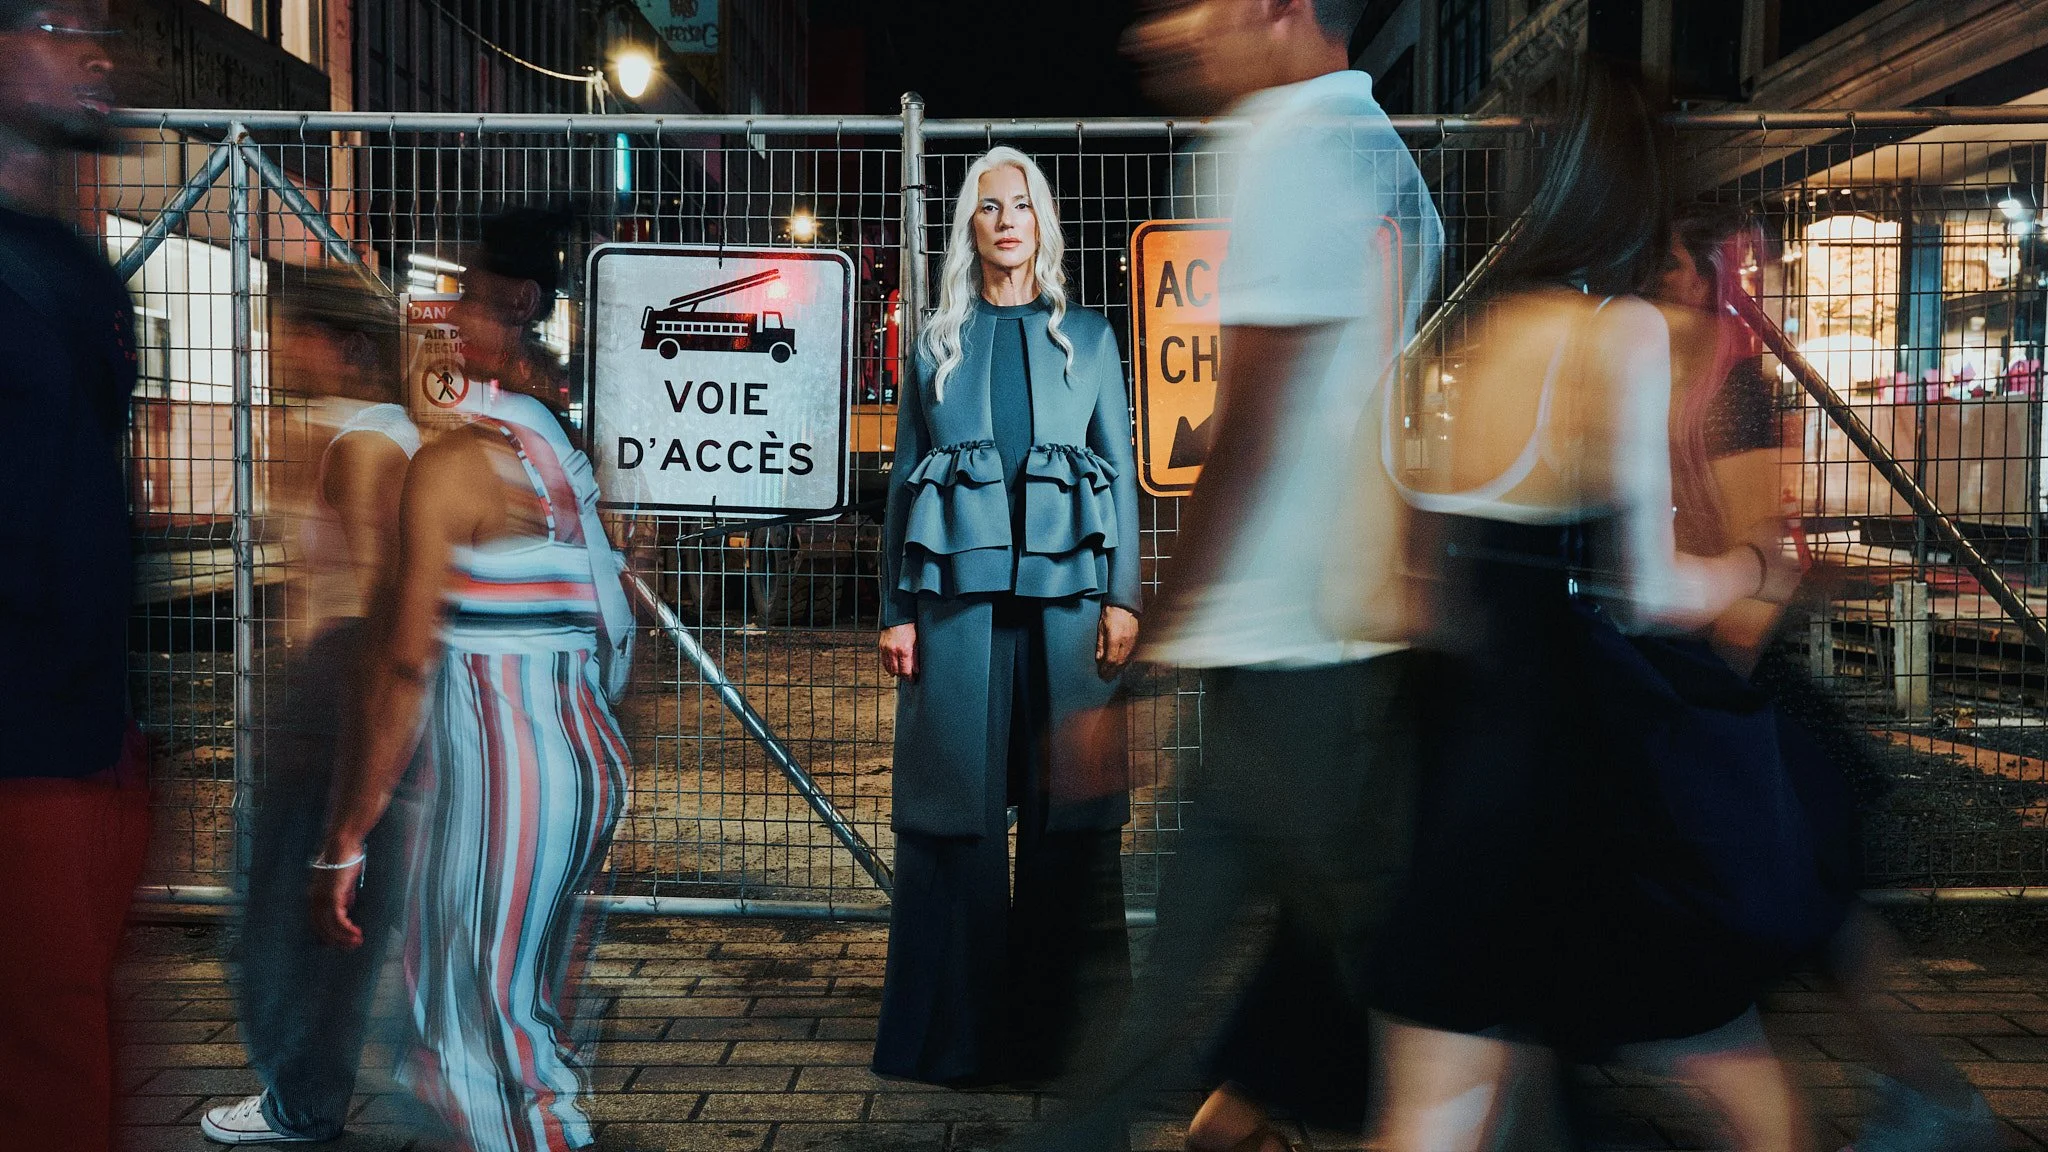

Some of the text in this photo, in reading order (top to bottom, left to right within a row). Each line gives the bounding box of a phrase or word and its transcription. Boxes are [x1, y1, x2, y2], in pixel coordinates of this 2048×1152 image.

[411, 306, 453, 319] DAN
[424, 329, 446, 339] AIR
[664, 380, 768, 416] VOIE
[617, 430, 814, 476] D’ACCÈS
